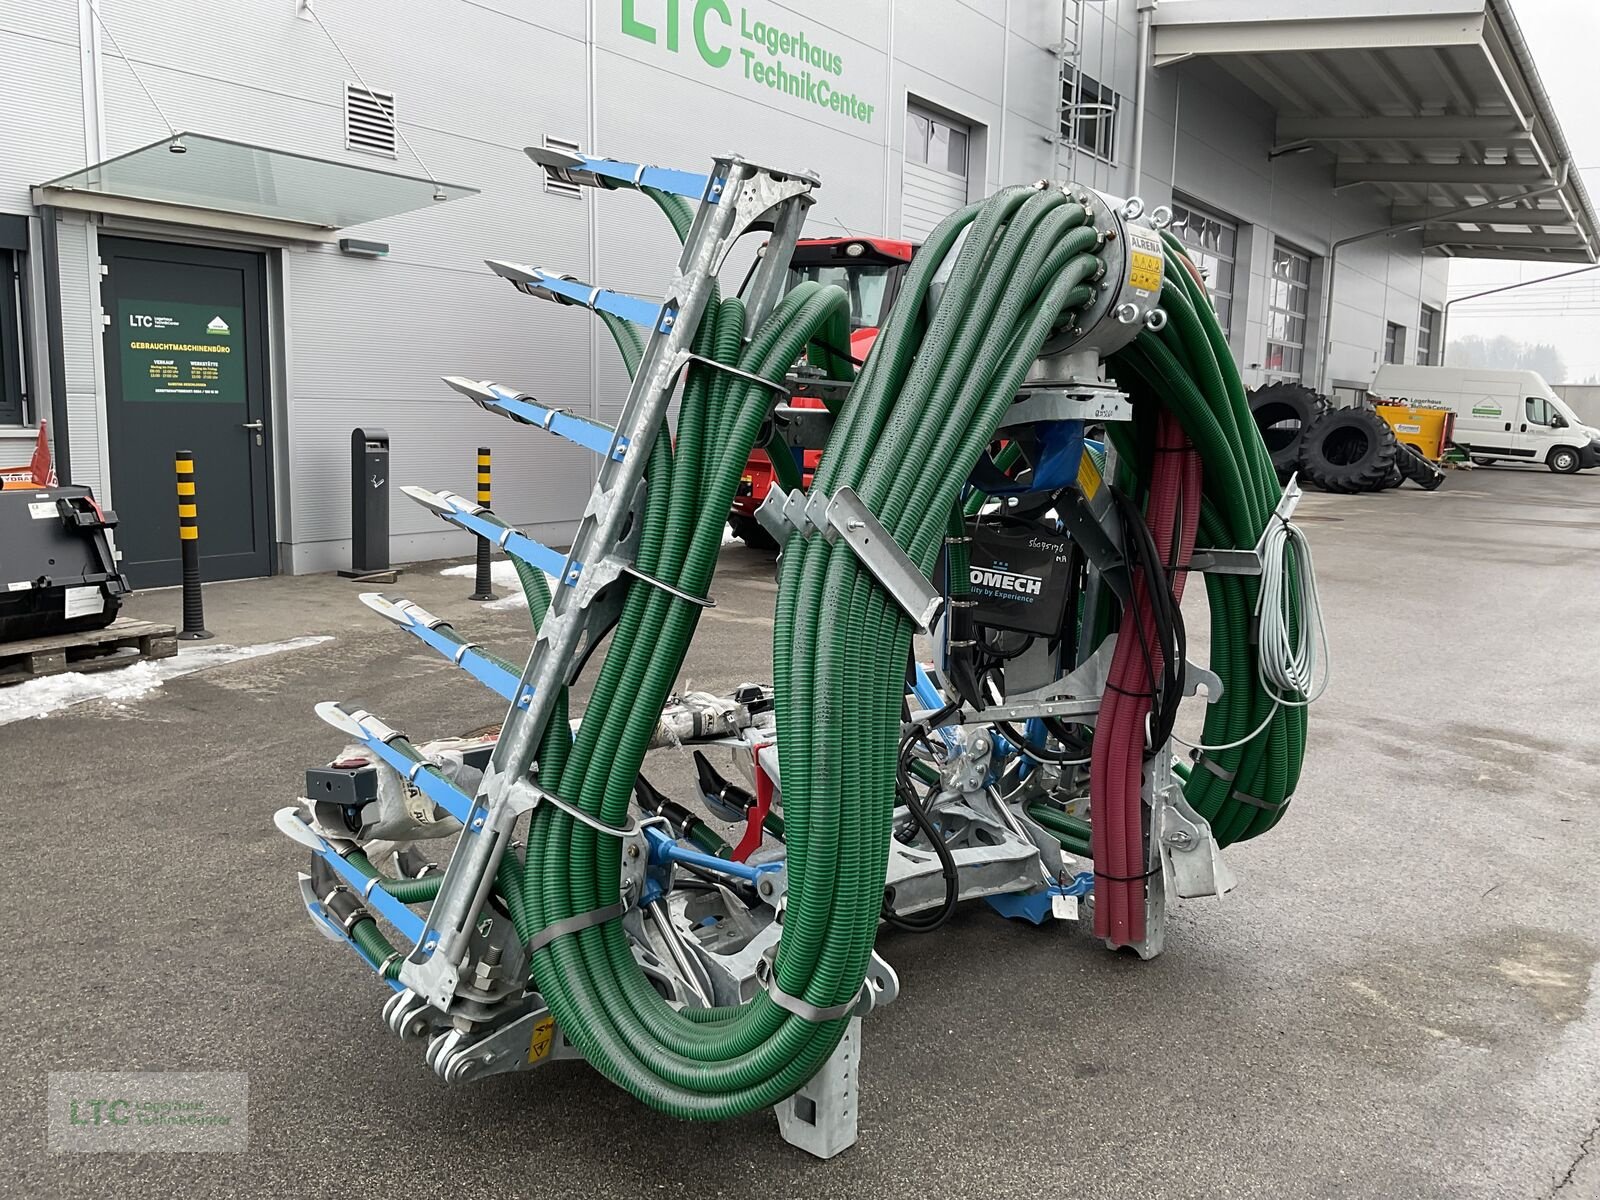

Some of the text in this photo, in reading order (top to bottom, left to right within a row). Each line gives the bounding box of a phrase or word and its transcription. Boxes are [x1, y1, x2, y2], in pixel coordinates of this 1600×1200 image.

[621, 0, 732, 68] LTC
[740, 7, 843, 76] Lagerhaus
[740, 47, 875, 124] TechnikCenter
[1131, 236, 1162, 254] ALRENA
[129, 314, 153, 328] LTC
[130, 341, 231, 353] GEBRAUCHTMASCHINENBÜRO
[969, 570, 1042, 595] OMECH
[970, 586, 1034, 603] lity by Experience
